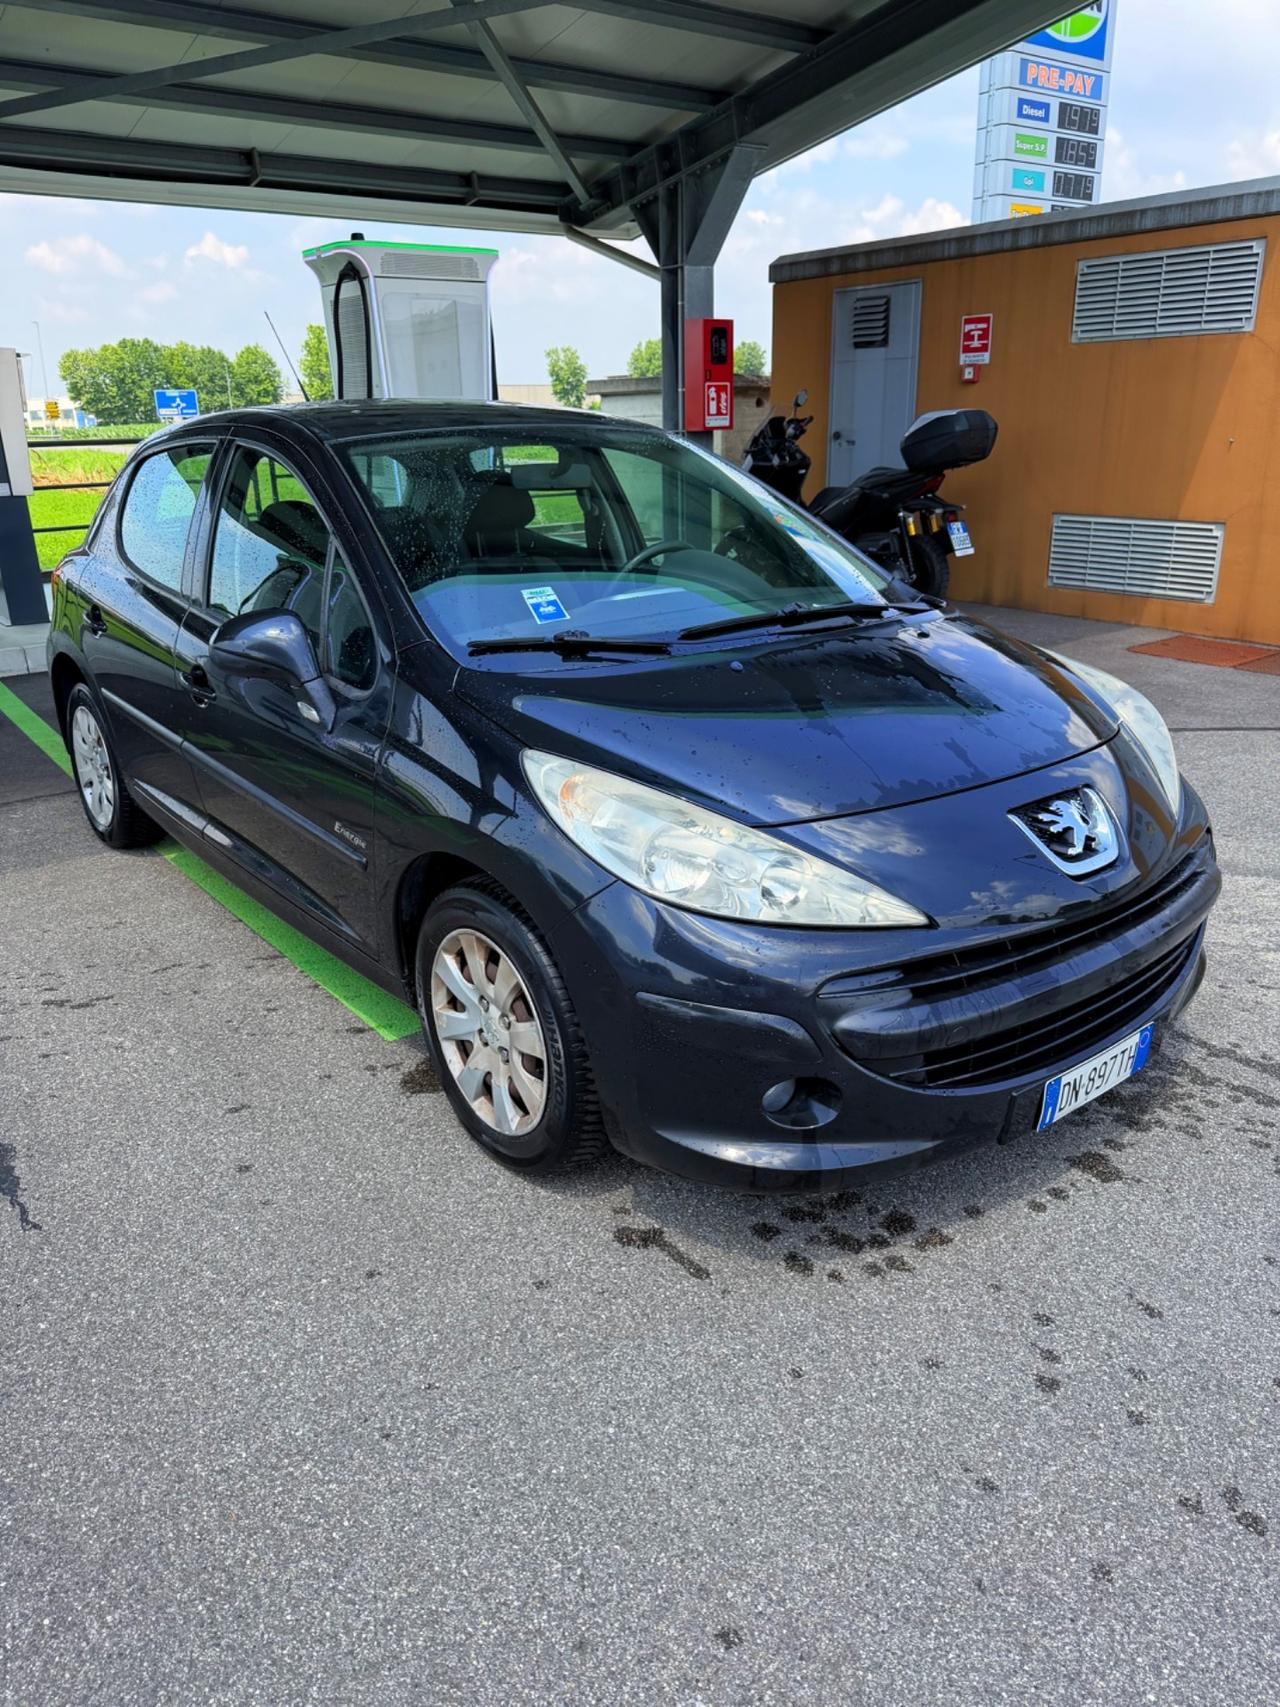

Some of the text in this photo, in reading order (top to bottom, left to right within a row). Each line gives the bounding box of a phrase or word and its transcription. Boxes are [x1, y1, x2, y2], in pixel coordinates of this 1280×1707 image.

[1027, 62, 1095, 96] PRE-PAY
[1022, 105, 1045, 118] Diesel
[1016, 139, 1034, 151] Super
[333, 821, 367, 849] Energie
